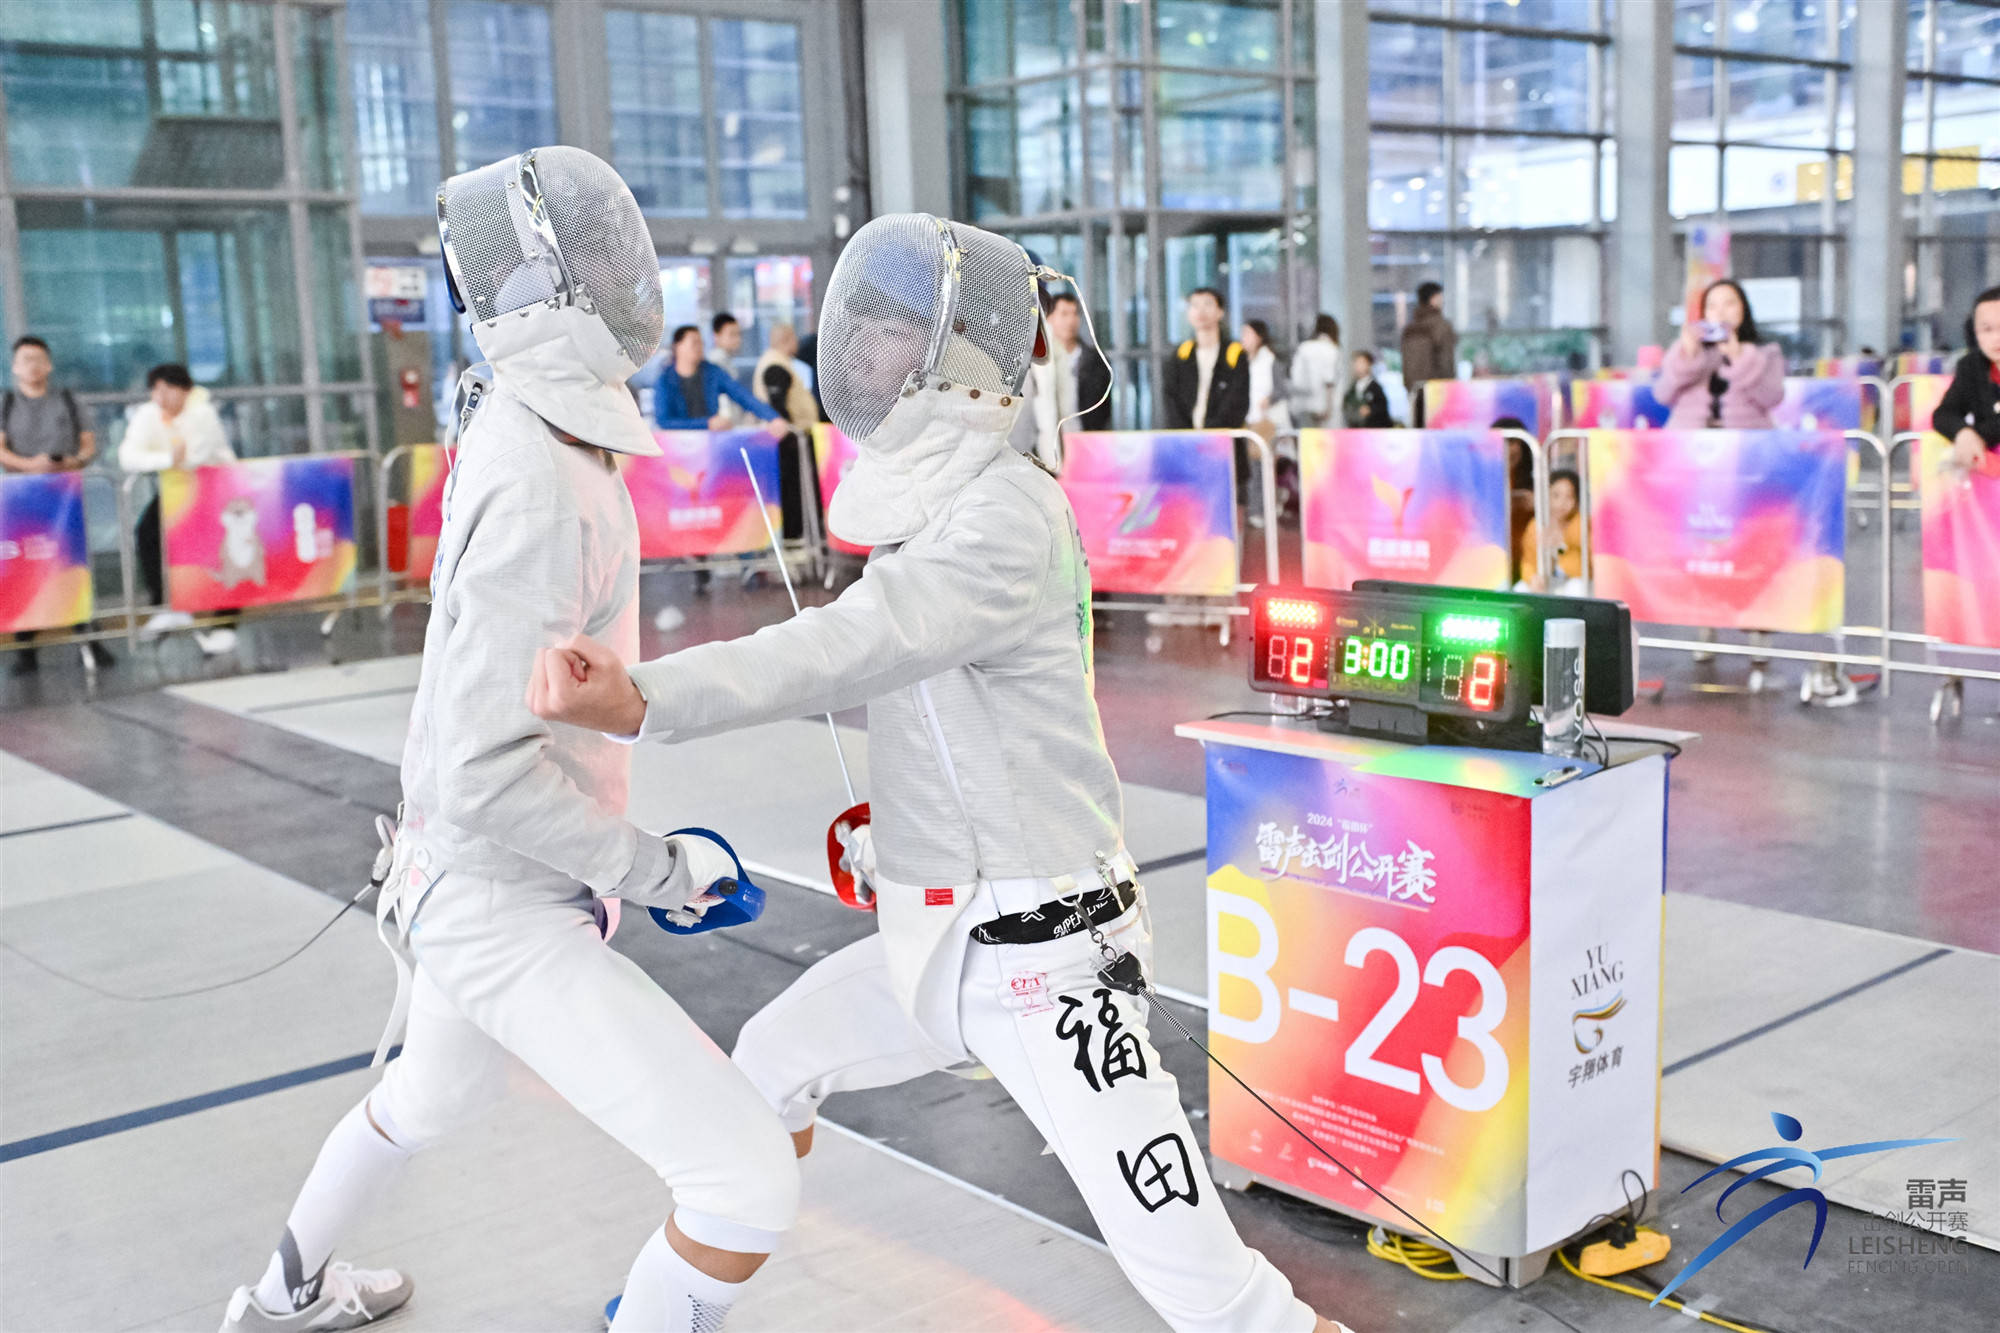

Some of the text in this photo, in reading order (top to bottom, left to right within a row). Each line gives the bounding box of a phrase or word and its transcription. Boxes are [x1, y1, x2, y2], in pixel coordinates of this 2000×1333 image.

[1290, 637, 1314, 684] 2
[1344, 637, 1411, 681] 3:00
[1468, 656, 1497, 706] 2
[1573, 657, 1585, 743] VOSS
[1307, 813, 1333, 827] 2024
[1586, 944, 1609, 969] YU
[1207, 888, 1510, 1112] B-23
[1571, 960, 1624, 1000] XIANG
[1568, 1046, 1624, 1088] 宇翔体育
